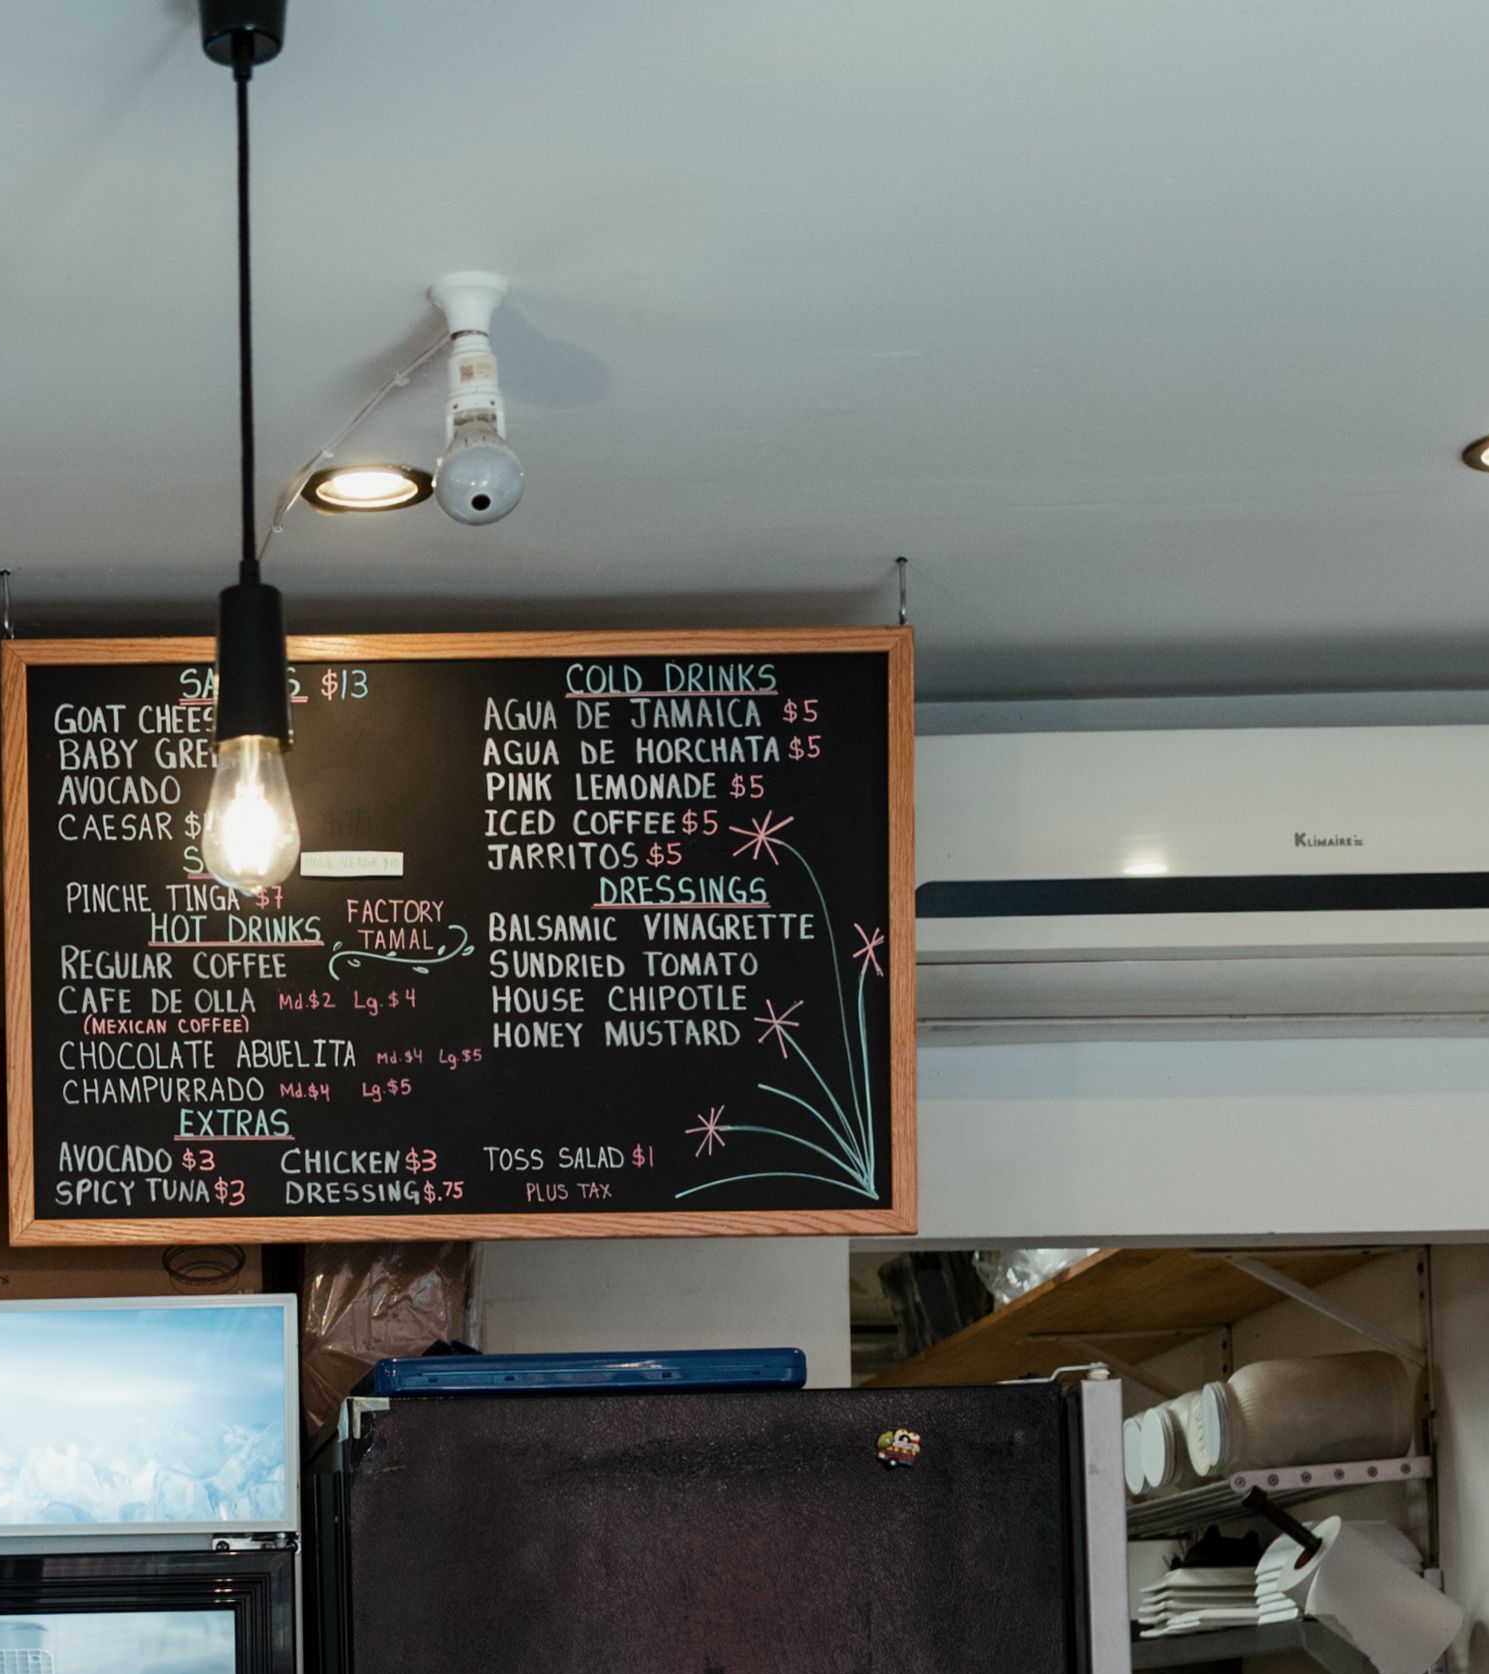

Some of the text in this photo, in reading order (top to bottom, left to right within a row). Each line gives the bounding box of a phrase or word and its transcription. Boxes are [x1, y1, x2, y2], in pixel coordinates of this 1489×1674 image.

[566, 663, 777, 697] COLD DRINKS
[487, 772, 764, 801] PINK LEMONADE $5
[488, 842, 681, 870] JARRITOS $5
[596, 875, 768, 908] DRESSINGS
[148, 913, 323, 944] HOT DRINKS
[494, 1020, 740, 1047] HONEY MUSTARD
[176, 1109, 293, 1139] EXTRAS
